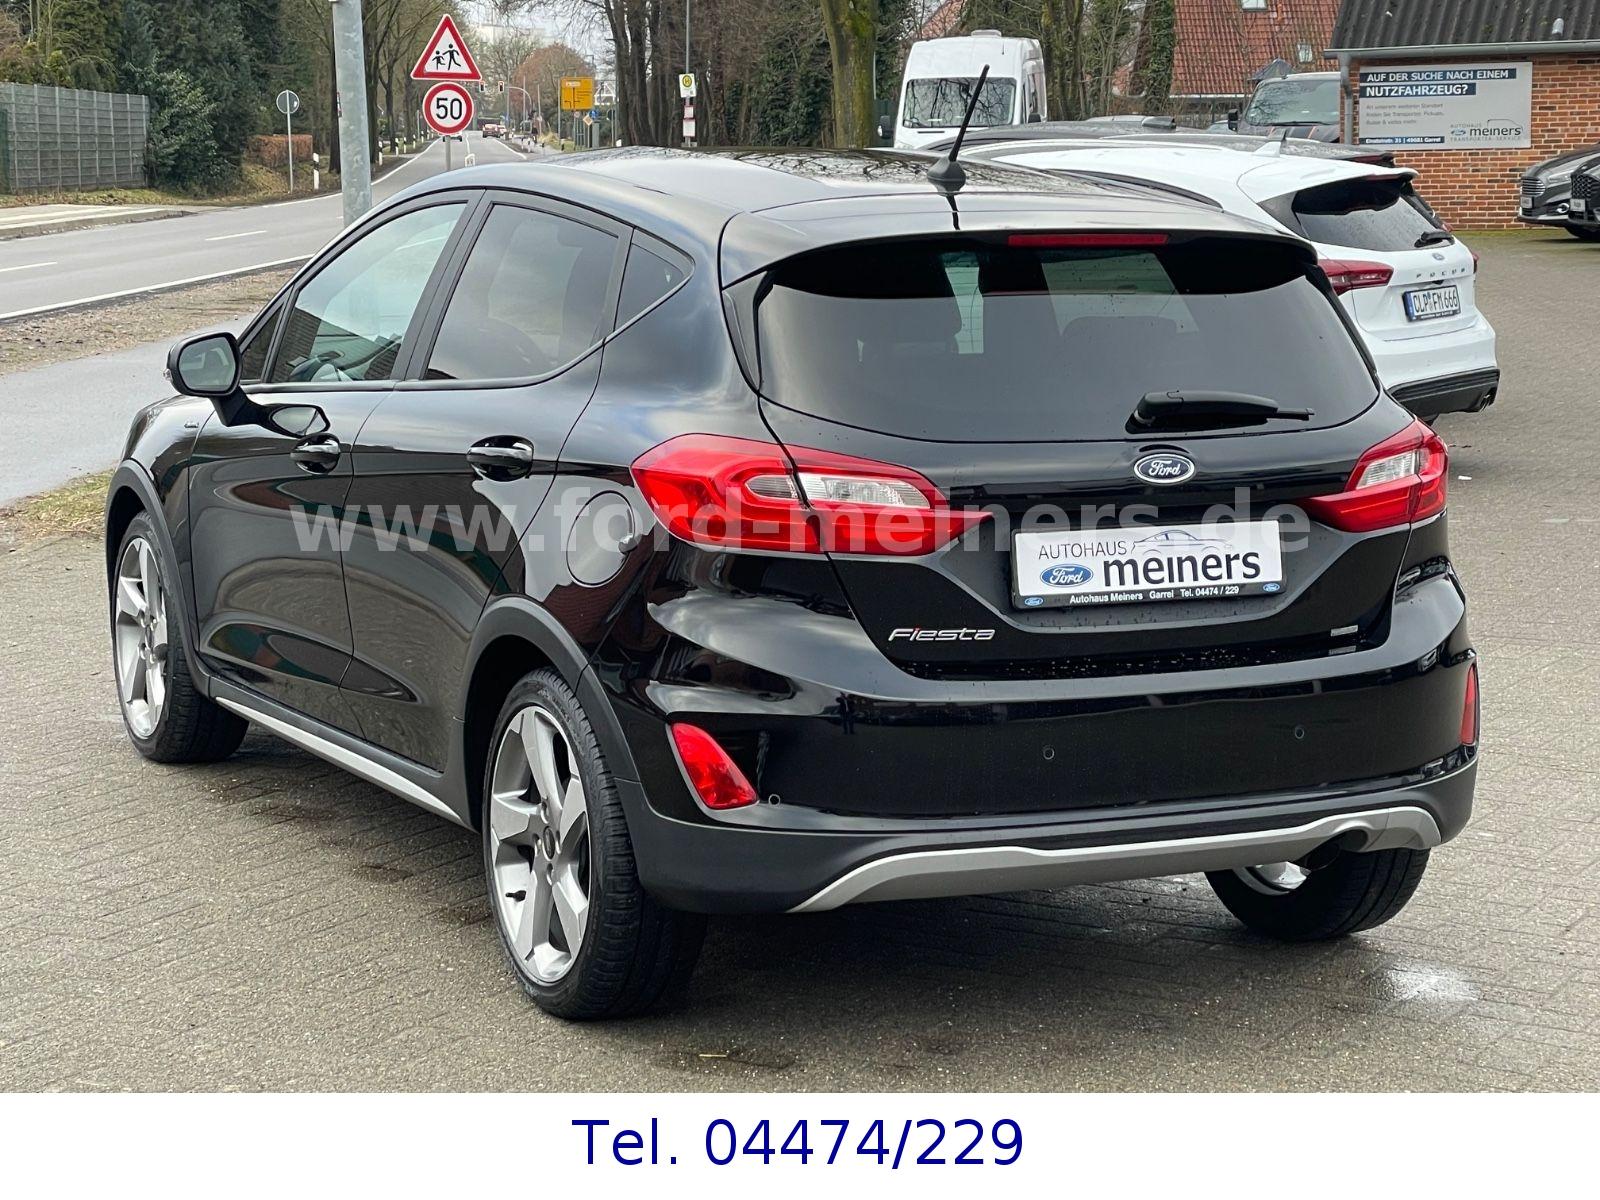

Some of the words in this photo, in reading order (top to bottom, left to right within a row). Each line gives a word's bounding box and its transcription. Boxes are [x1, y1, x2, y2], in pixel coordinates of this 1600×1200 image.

[1367, 74, 1386, 82] AUF
[1389, 73, 1409, 81] DER
[1411, 71, 1443, 81] SUCHE
[1446, 70, 1474, 80] NACH
[1476, 69, 1509, 79] EINEM
[1366, 84, 1468, 97] NUTZFAHRZEUG?
[436, 98, 463, 120] 50
[1470, 127, 1521, 136] meiners
[1149, 460, 1181, 476] Ford
[1038, 540, 1127, 560] AUTOHAUS
[1048, 564, 1084, 585] Ford
[1103, 551, 1261, 587] meiners
[1069, 594, 1109, 604] Autohaus
[1110, 592, 1143, 602] Meiners
[1149, 589, 1174, 599] Garrel
[1180, 588, 1194, 598] Tel.
[1195, 587, 1218, 597] 04474
[1225, 585, 1239, 595] 229
[888, 627, 995, 641] Fiesta
